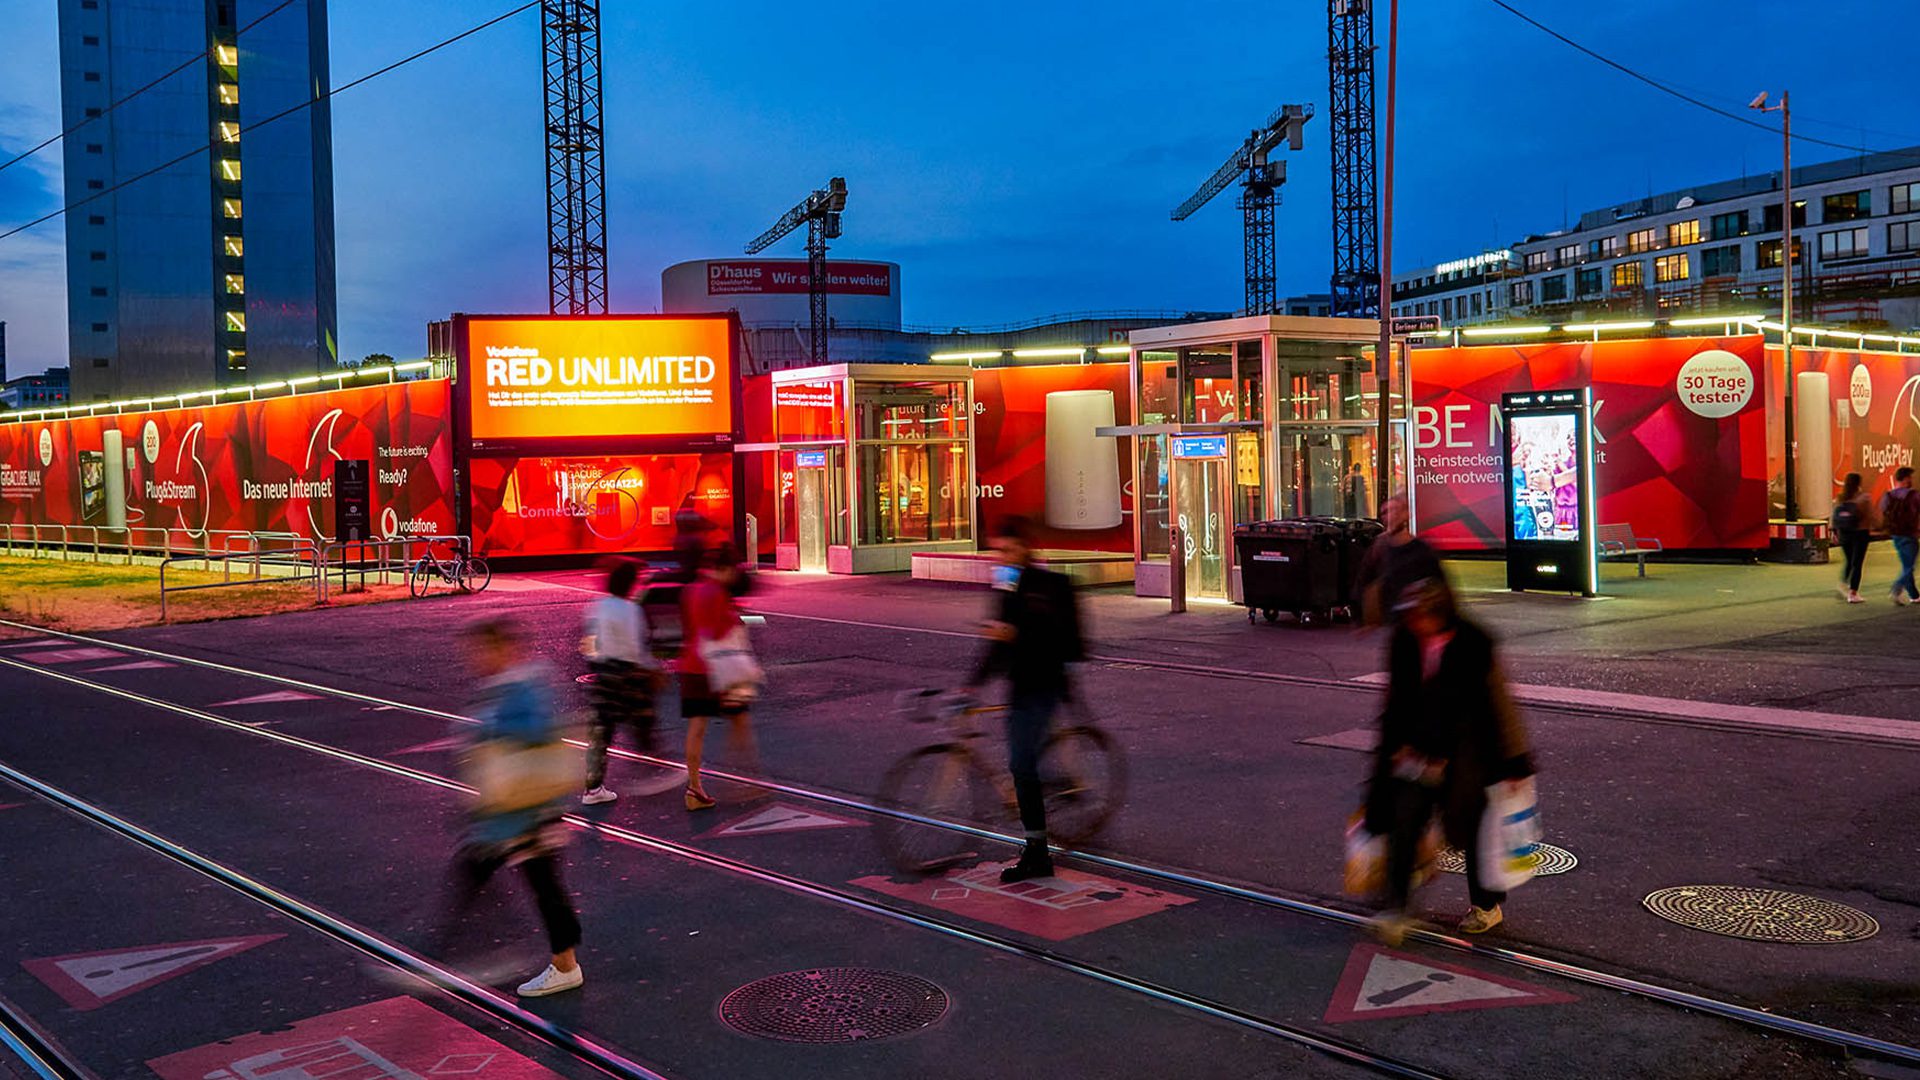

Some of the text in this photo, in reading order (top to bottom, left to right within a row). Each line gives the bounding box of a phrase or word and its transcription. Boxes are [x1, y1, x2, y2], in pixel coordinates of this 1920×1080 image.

[711, 266, 762, 278] D'haus
[772, 272, 797, 284] Wir
[849, 275, 887, 287] weiter!
[486, 355, 716, 386] RED UNLIMITED
[1683, 375, 1746, 391] 30 Tage
[1430, 453, 1503, 467] einstecken
[1862, 443, 1913, 473] Plug&Play
[379, 468, 407, 487] Ready?
[146, 480, 196, 503] Plug&Stream
[243, 479, 262, 499] Das
[263, 483, 288, 499] neue
[289, 477, 332, 499] Internet
[399, 517, 438, 533] vodafone
